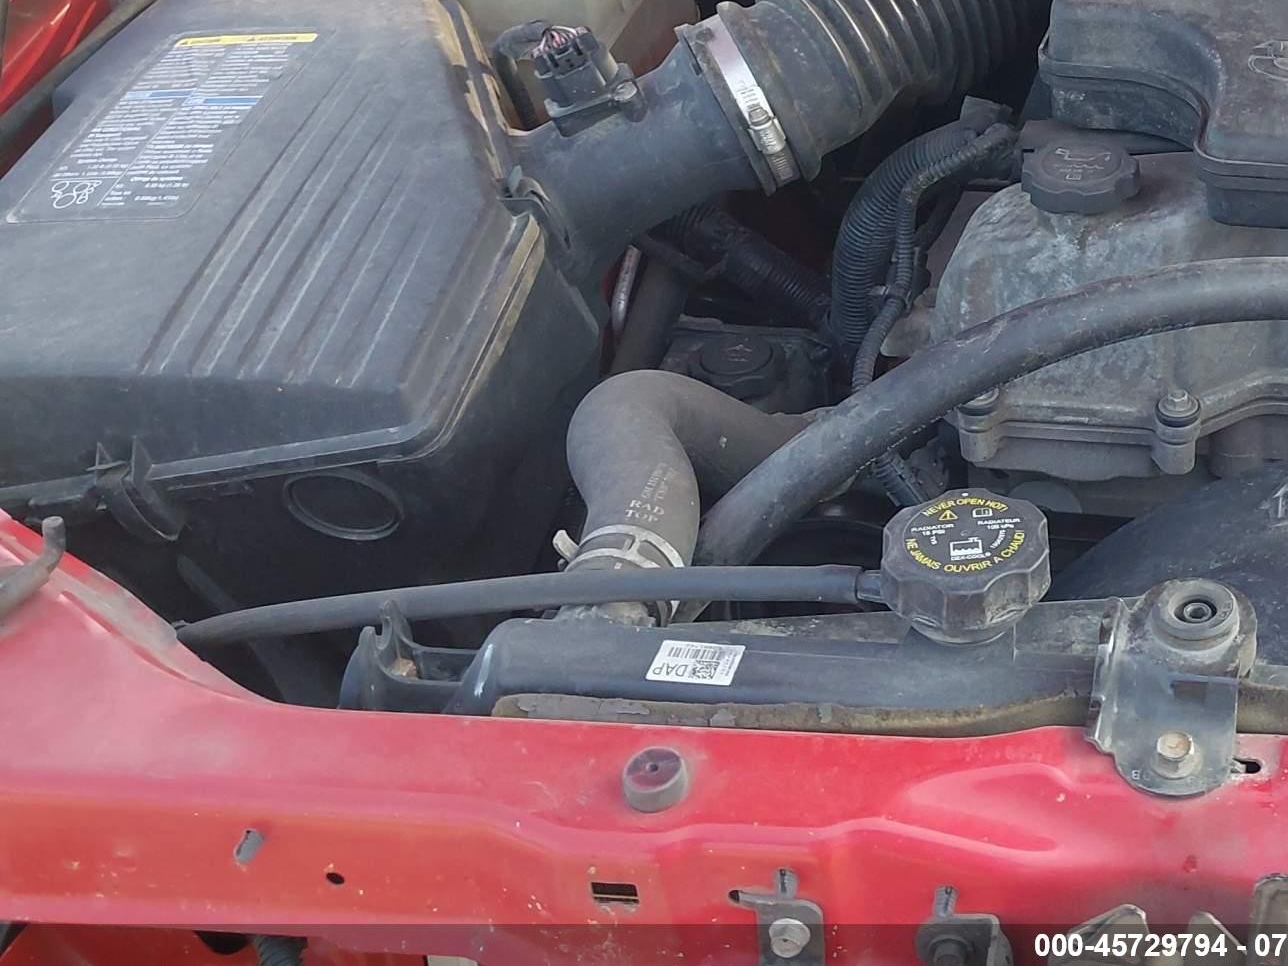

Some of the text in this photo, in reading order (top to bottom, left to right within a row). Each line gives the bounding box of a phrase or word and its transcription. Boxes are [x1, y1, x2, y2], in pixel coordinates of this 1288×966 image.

[629, 499, 665, 515] RAD
[922, 500, 956, 517] NEVER
[625, 509, 659, 523] TOP
[911, 523, 955, 532] RADIATOR
[905, 538, 918, 550] NE
[911, 550, 942, 570] JAMAIS
[944, 561, 992, 573] OUVRIR
[652, 662, 687, 677] DAP
